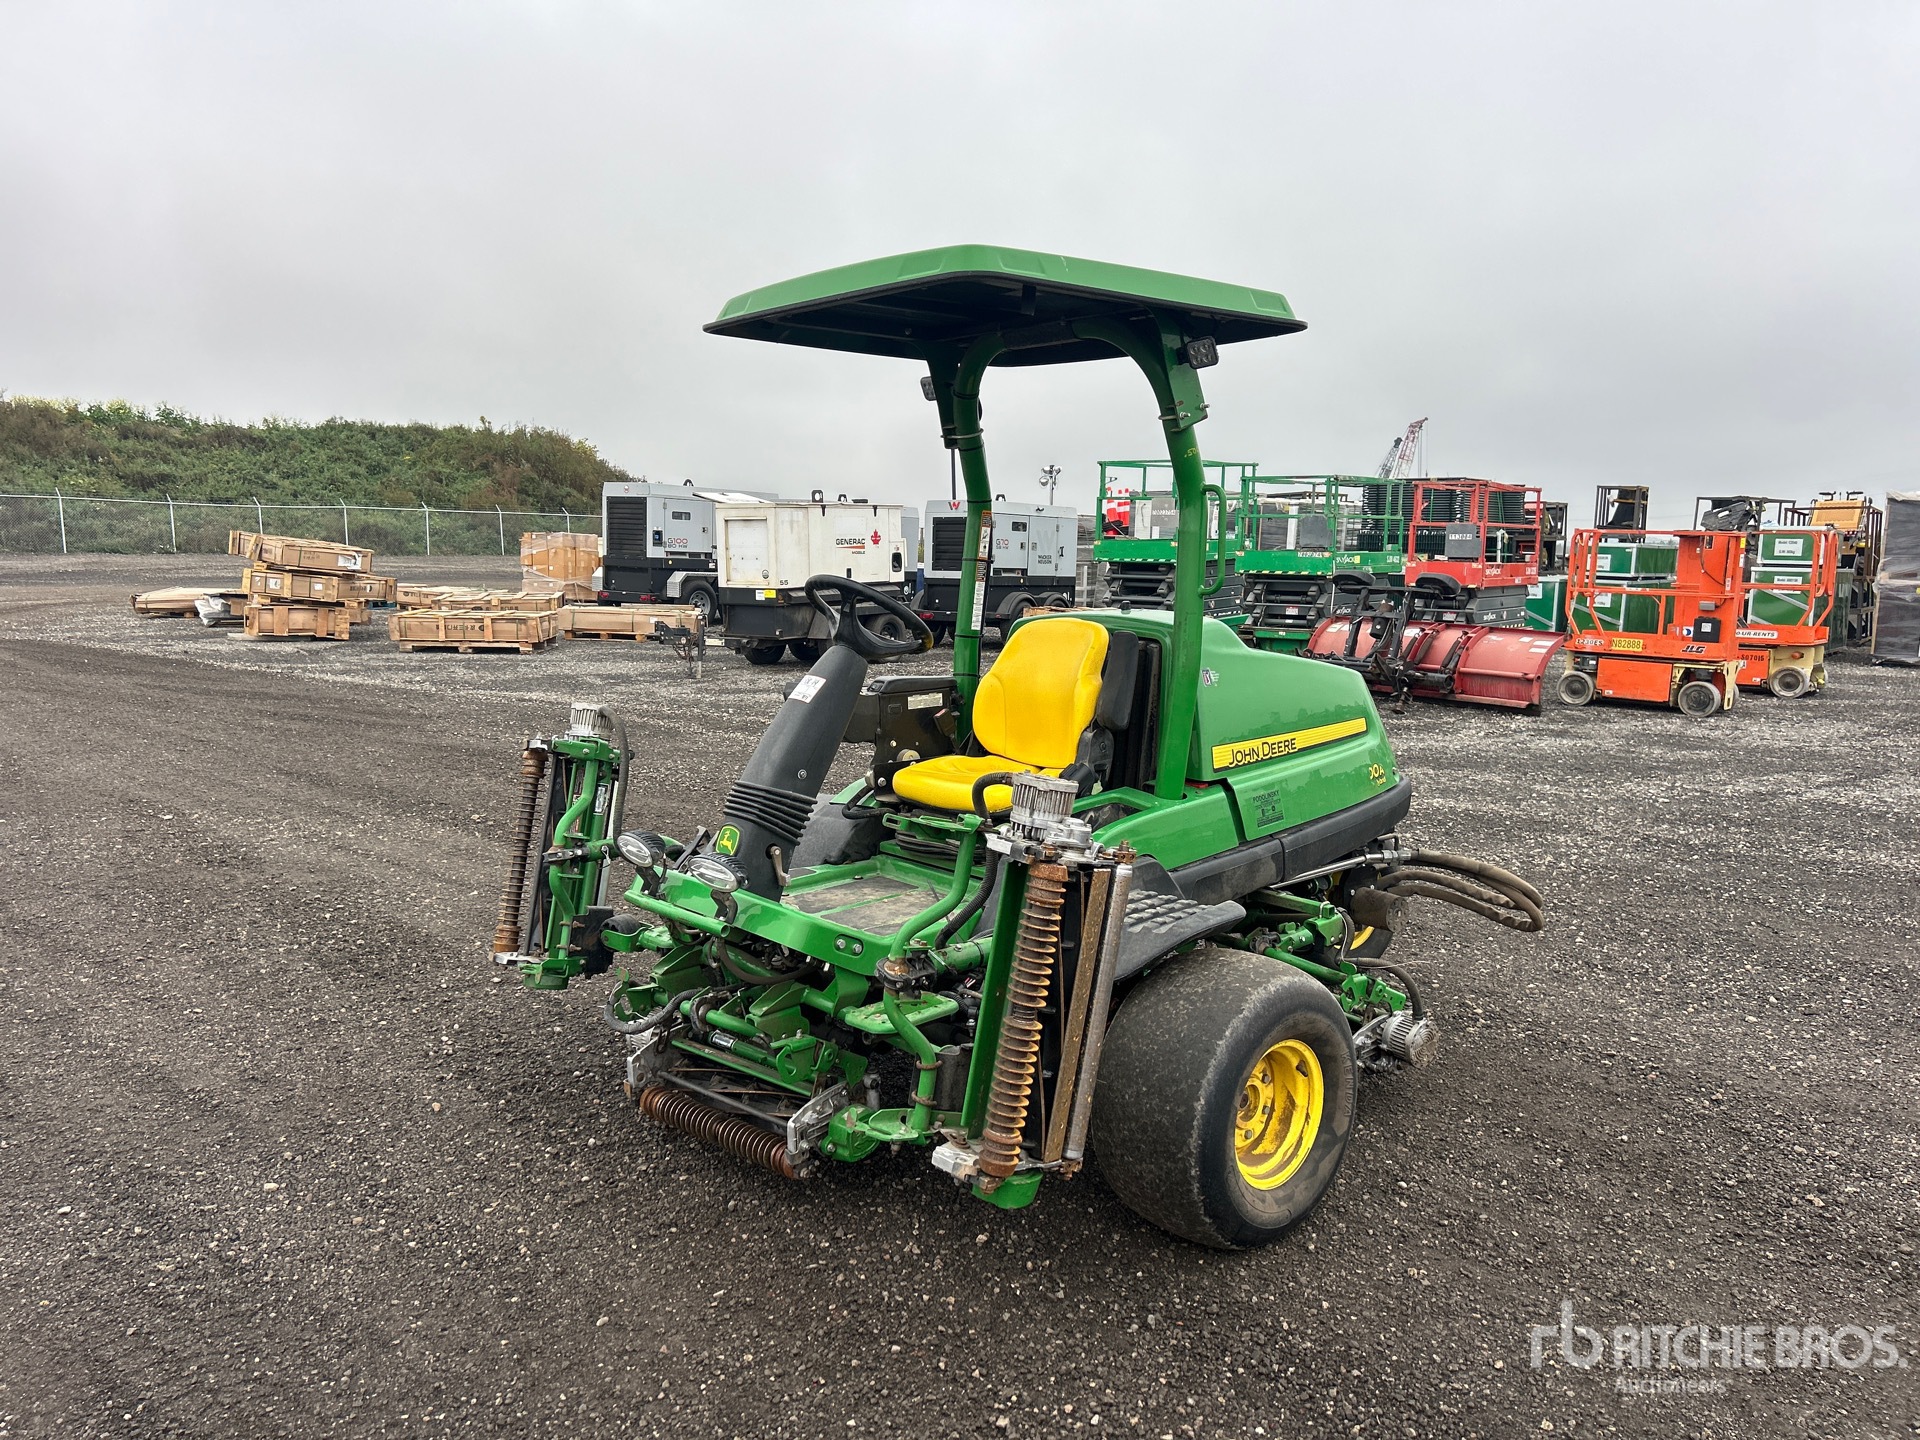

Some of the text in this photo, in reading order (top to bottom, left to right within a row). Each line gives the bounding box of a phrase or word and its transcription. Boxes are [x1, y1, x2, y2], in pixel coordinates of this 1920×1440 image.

[835, 538, 866, 546] GENERAC
[996, 538, 1010, 546] G70
[1612, 638, 1641, 650] N82888
[1682, 644, 1706, 654] JLG
[1228, 737, 1297, 766] JOHN DEERE
[1340, 1048, 1354, 1117] KENDA
